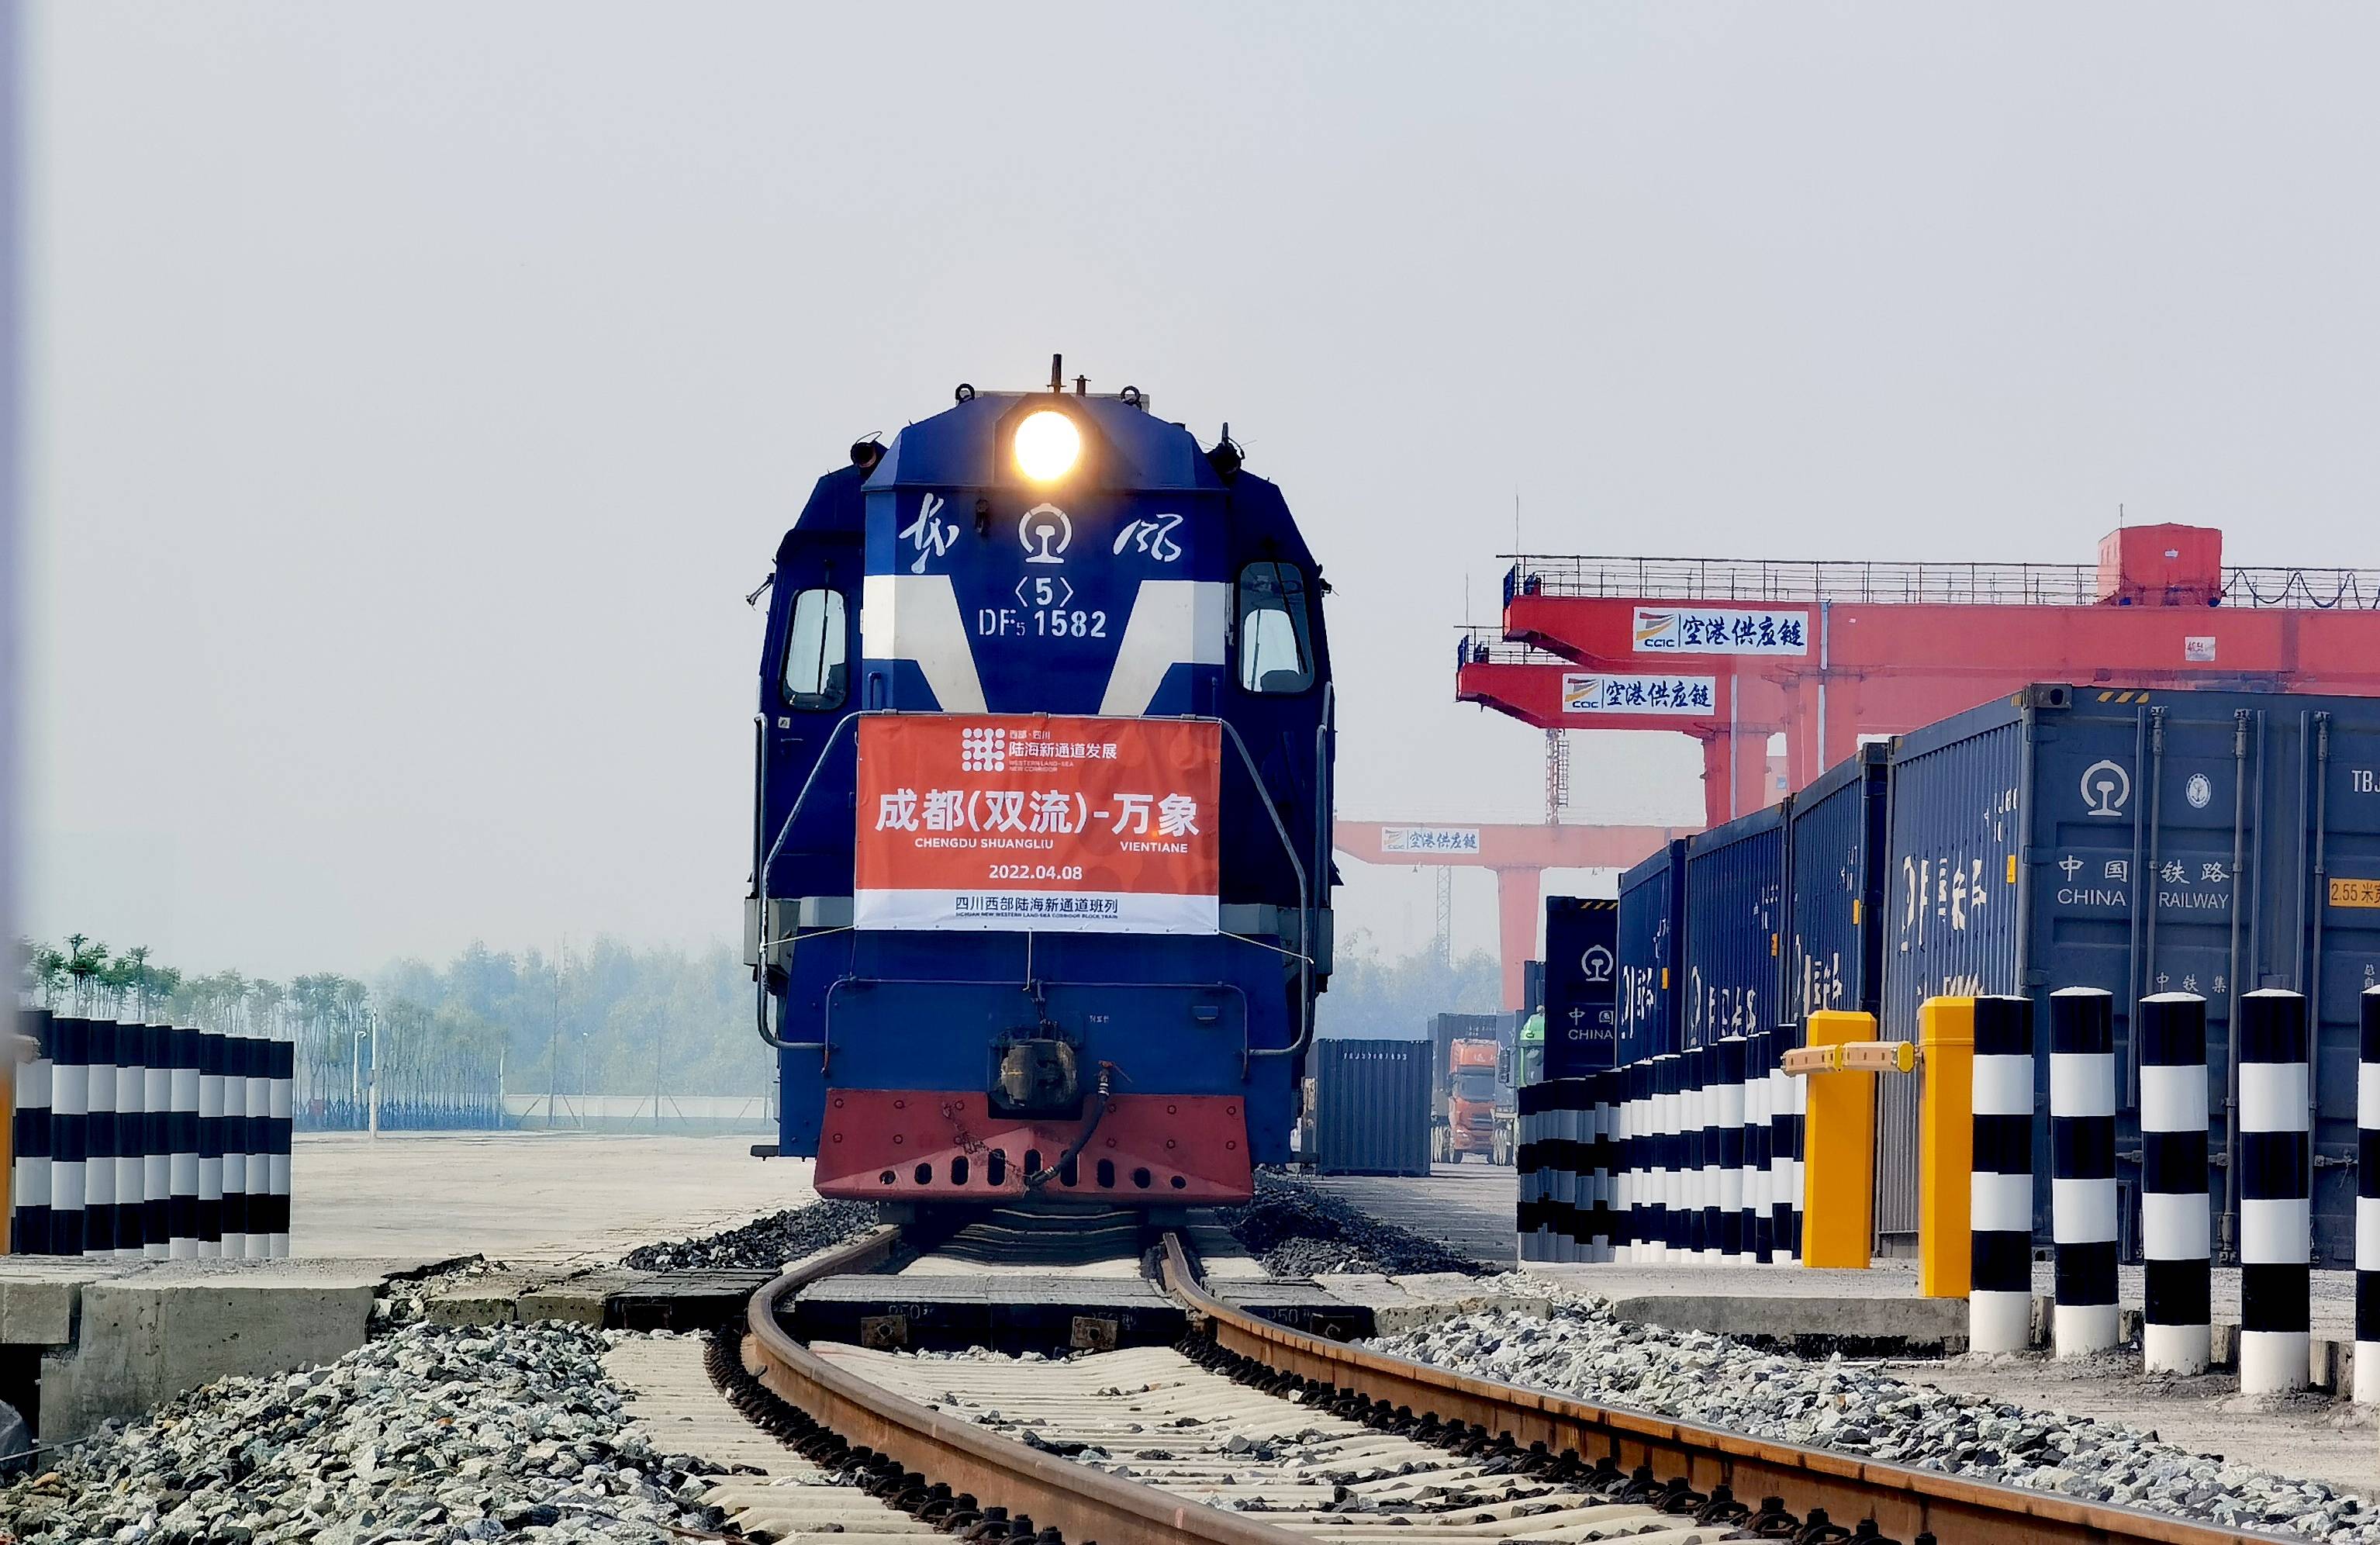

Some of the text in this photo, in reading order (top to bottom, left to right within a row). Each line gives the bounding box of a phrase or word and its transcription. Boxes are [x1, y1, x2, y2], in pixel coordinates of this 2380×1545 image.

[1034, 610, 1106, 638] 1582
[1683, 615, 1805, 648] 空港供应链
[1606, 680, 1712, 708] 空港供应链
[1009, 741, 1117, 759] 陆海新通道发展
[914, 838, 1188, 853] CHENGDU SHUANGLIU VIENTIANE
[989, 865, 1083, 880] 2022.04.08
[2057, 889, 2229, 909] CHINA RAILWAY
[2331, 883, 2358, 900] 2.55
[955, 897, 1118, 913] 四川西部陆海新通道班列
[1568, 1029, 1614, 1040] CHINA
